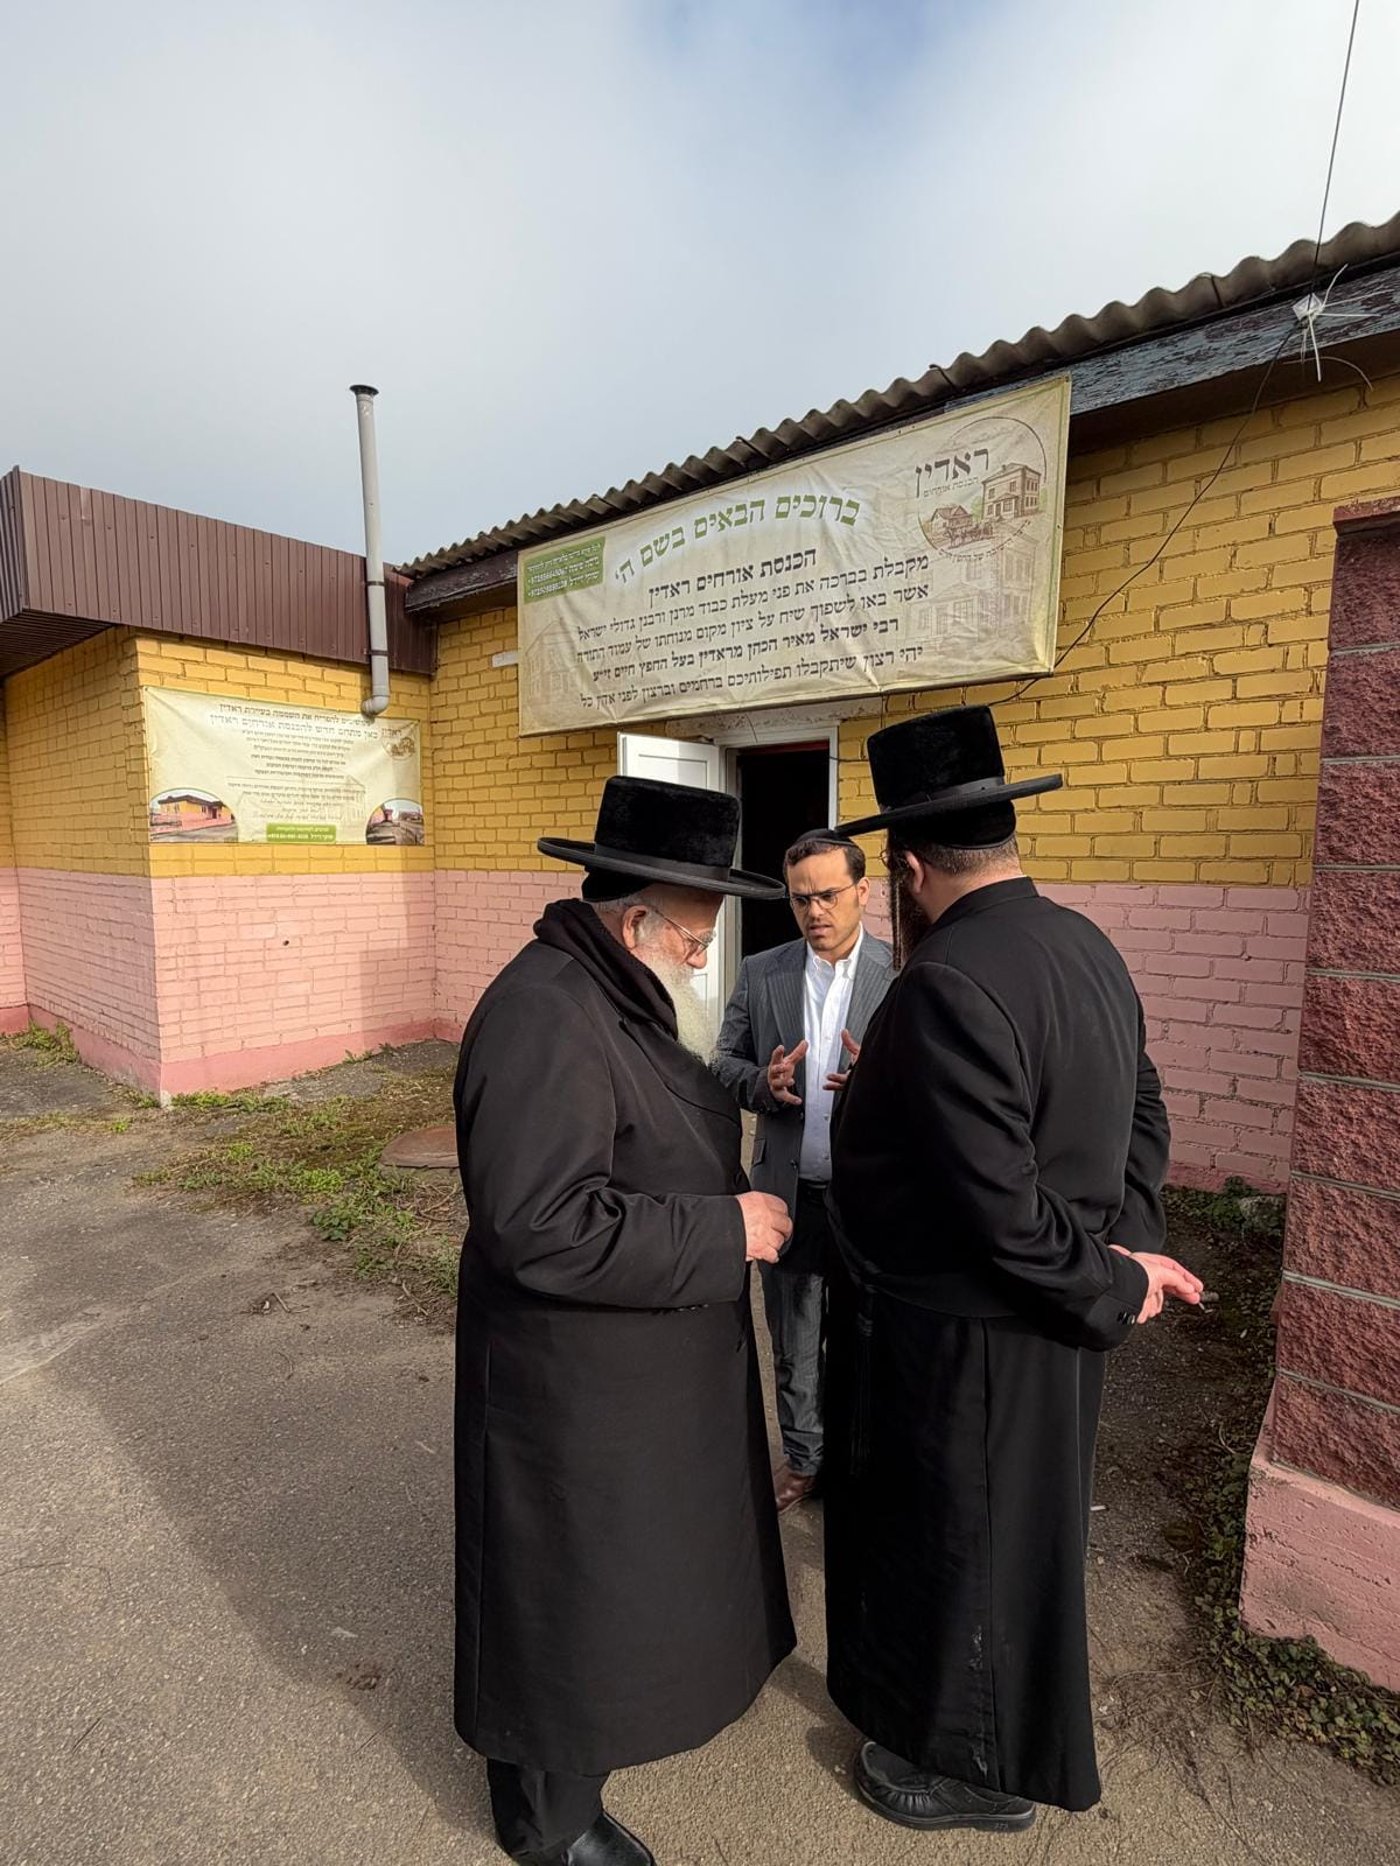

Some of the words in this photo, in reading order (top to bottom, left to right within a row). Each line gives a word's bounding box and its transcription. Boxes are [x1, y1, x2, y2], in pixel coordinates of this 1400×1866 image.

[915, 448, 989, 499] ראדין
[694, 499, 765, 539] הבאים
[775, 494, 860, 527] ברוכים
[639, 526, 686, 567] בשם
[760, 549, 816, 578] הכנסת
[873, 555, 928, 580] מקבלת
[696, 565, 754, 592] אורחים
[795, 580, 815, 596] את
[820, 569, 867, 590] בברכה
[648, 580, 690, 609] ראדין
[731, 589, 768, 610] מעלת
[772, 585, 791, 599] פני
[860, 592, 886, 609] באו
[893, 584, 929, 603] אשר
[669, 605, 694, 625] מרנן
[698, 599, 727, 615] כבוד
[780, 608, 805, 624] שיח
[810, 593, 855, 622] לשפוך
[610, 614, 635, 633] גדולי
[639, 612, 665, 632] ורבנן
[731, 618, 754, 638] ציון
[758, 611, 775, 628] על
[873, 618, 899, 635] רבי
[577, 625, 607, 641] ישראל
[654, 630, 692, 648] מנוחתו
[696, 623, 727, 642] מקום
[782, 632, 815, 649] מאיר
[820, 623, 868, 643] ישראל
[608, 641, 632, 656] עמוד
[635, 635, 651, 650] של
[747, 638, 778, 662] הכהן
[577, 646, 605, 663] התורה
[671, 650, 694, 668] בעל
[698, 644, 743, 668] מראדין
[863, 651, 894, 672] רצון
[900, 646, 923, 662] יהי
[614, 664, 635, 678] חיים
[639, 658, 668, 678] החפץ
[727, 664, 792, 686] תפילותיכם
[796, 655, 857, 679] שיתקבלו
[618, 685, 639, 702] לפני
[641, 684, 676, 704] וברצון
[678, 676, 723, 694] ברחמים
[219, 703, 243, 712] ראדין
[580, 693, 593, 707] כל
[596, 693, 615, 709] אדון
[210, 714, 239, 728] ראדין
